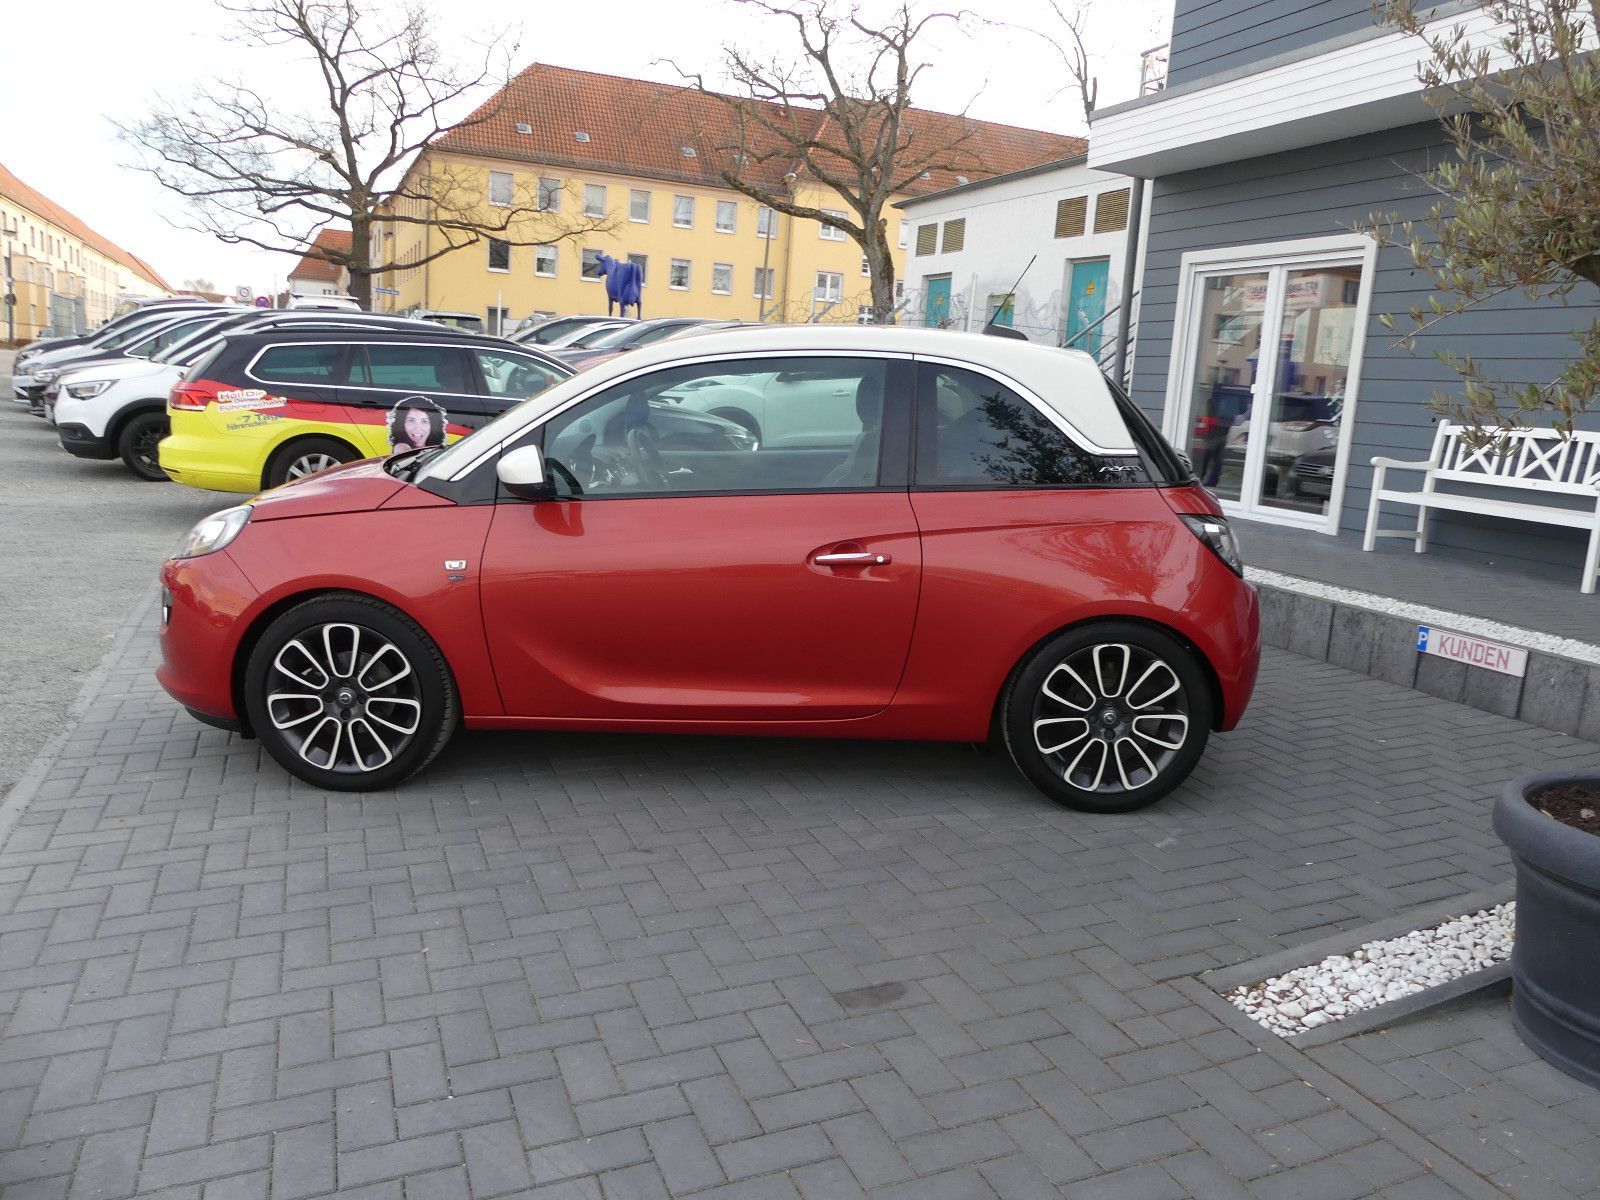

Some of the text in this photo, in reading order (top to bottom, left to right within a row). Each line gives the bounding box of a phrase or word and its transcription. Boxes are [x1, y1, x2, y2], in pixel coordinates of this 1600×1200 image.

[220, 392, 241, 400] Hol
[1417, 631, 1510, 670] P KUNDEN
